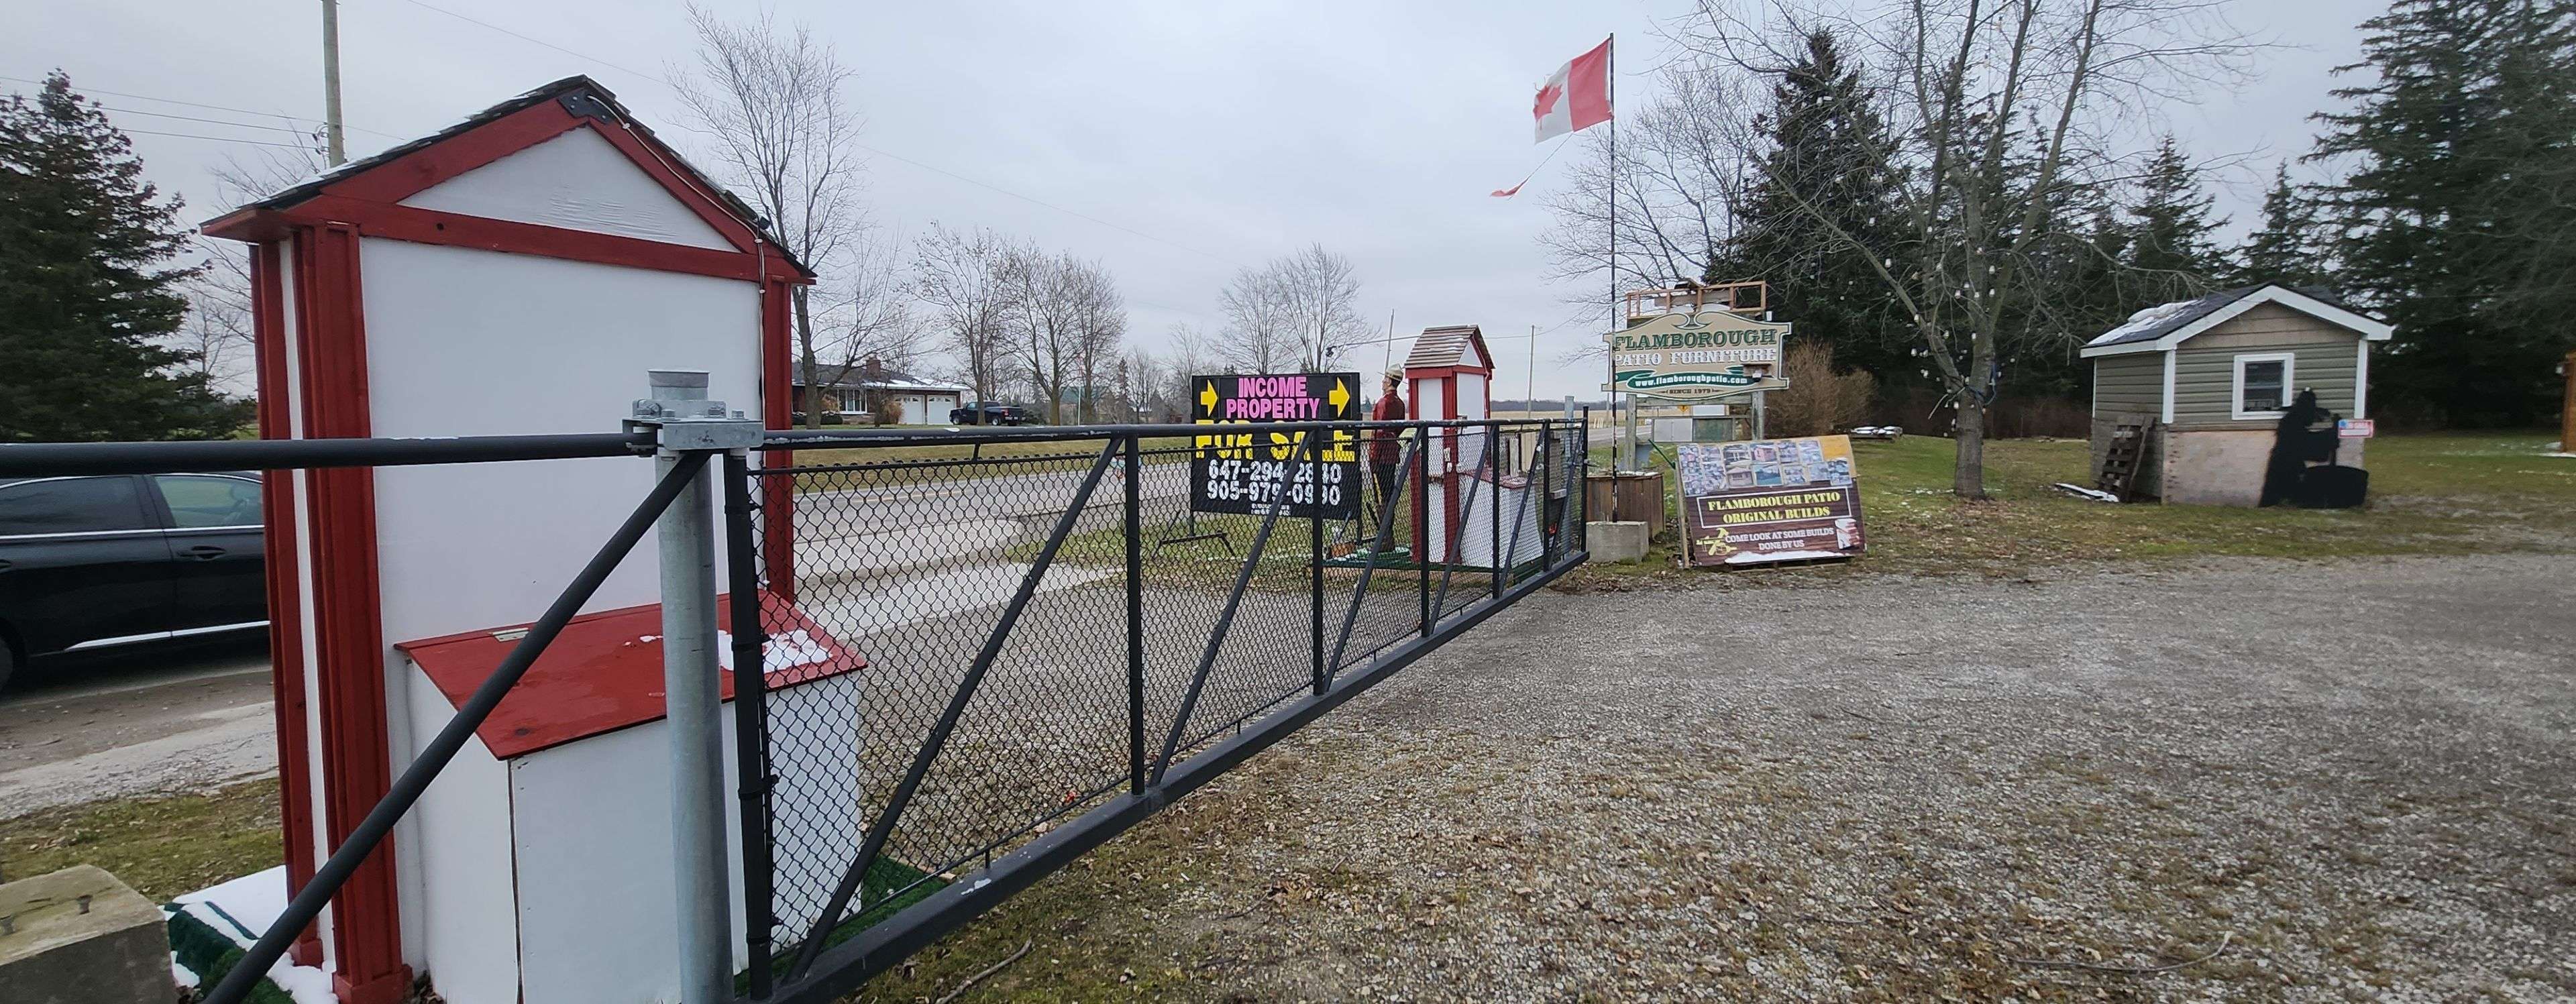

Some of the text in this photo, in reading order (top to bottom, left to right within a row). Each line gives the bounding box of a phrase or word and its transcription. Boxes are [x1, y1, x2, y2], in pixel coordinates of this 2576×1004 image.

[1614, 329, 1777, 351] FLAMBOROUGH
[1615, 348, 1776, 366] PATIO FURNITURE
[1238, 376, 1307, 398] INCOME
[1635, 374, 1748, 387] www.flamboroughpatio.com
[1226, 397, 1320, 419] PROPERTY
[1195, 419, 1355, 462] FOR SAE
[1708, 492, 1841, 511] FLAMBOROUGH PATIO
[1723, 506, 1831, 524] ORIGINAL BUILDS
[1725, 527, 1834, 543] COME LOOK AT SOME BUILDS
[1758, 541, 1782, 550] DONE
[1794, 539, 1805, 547] US
